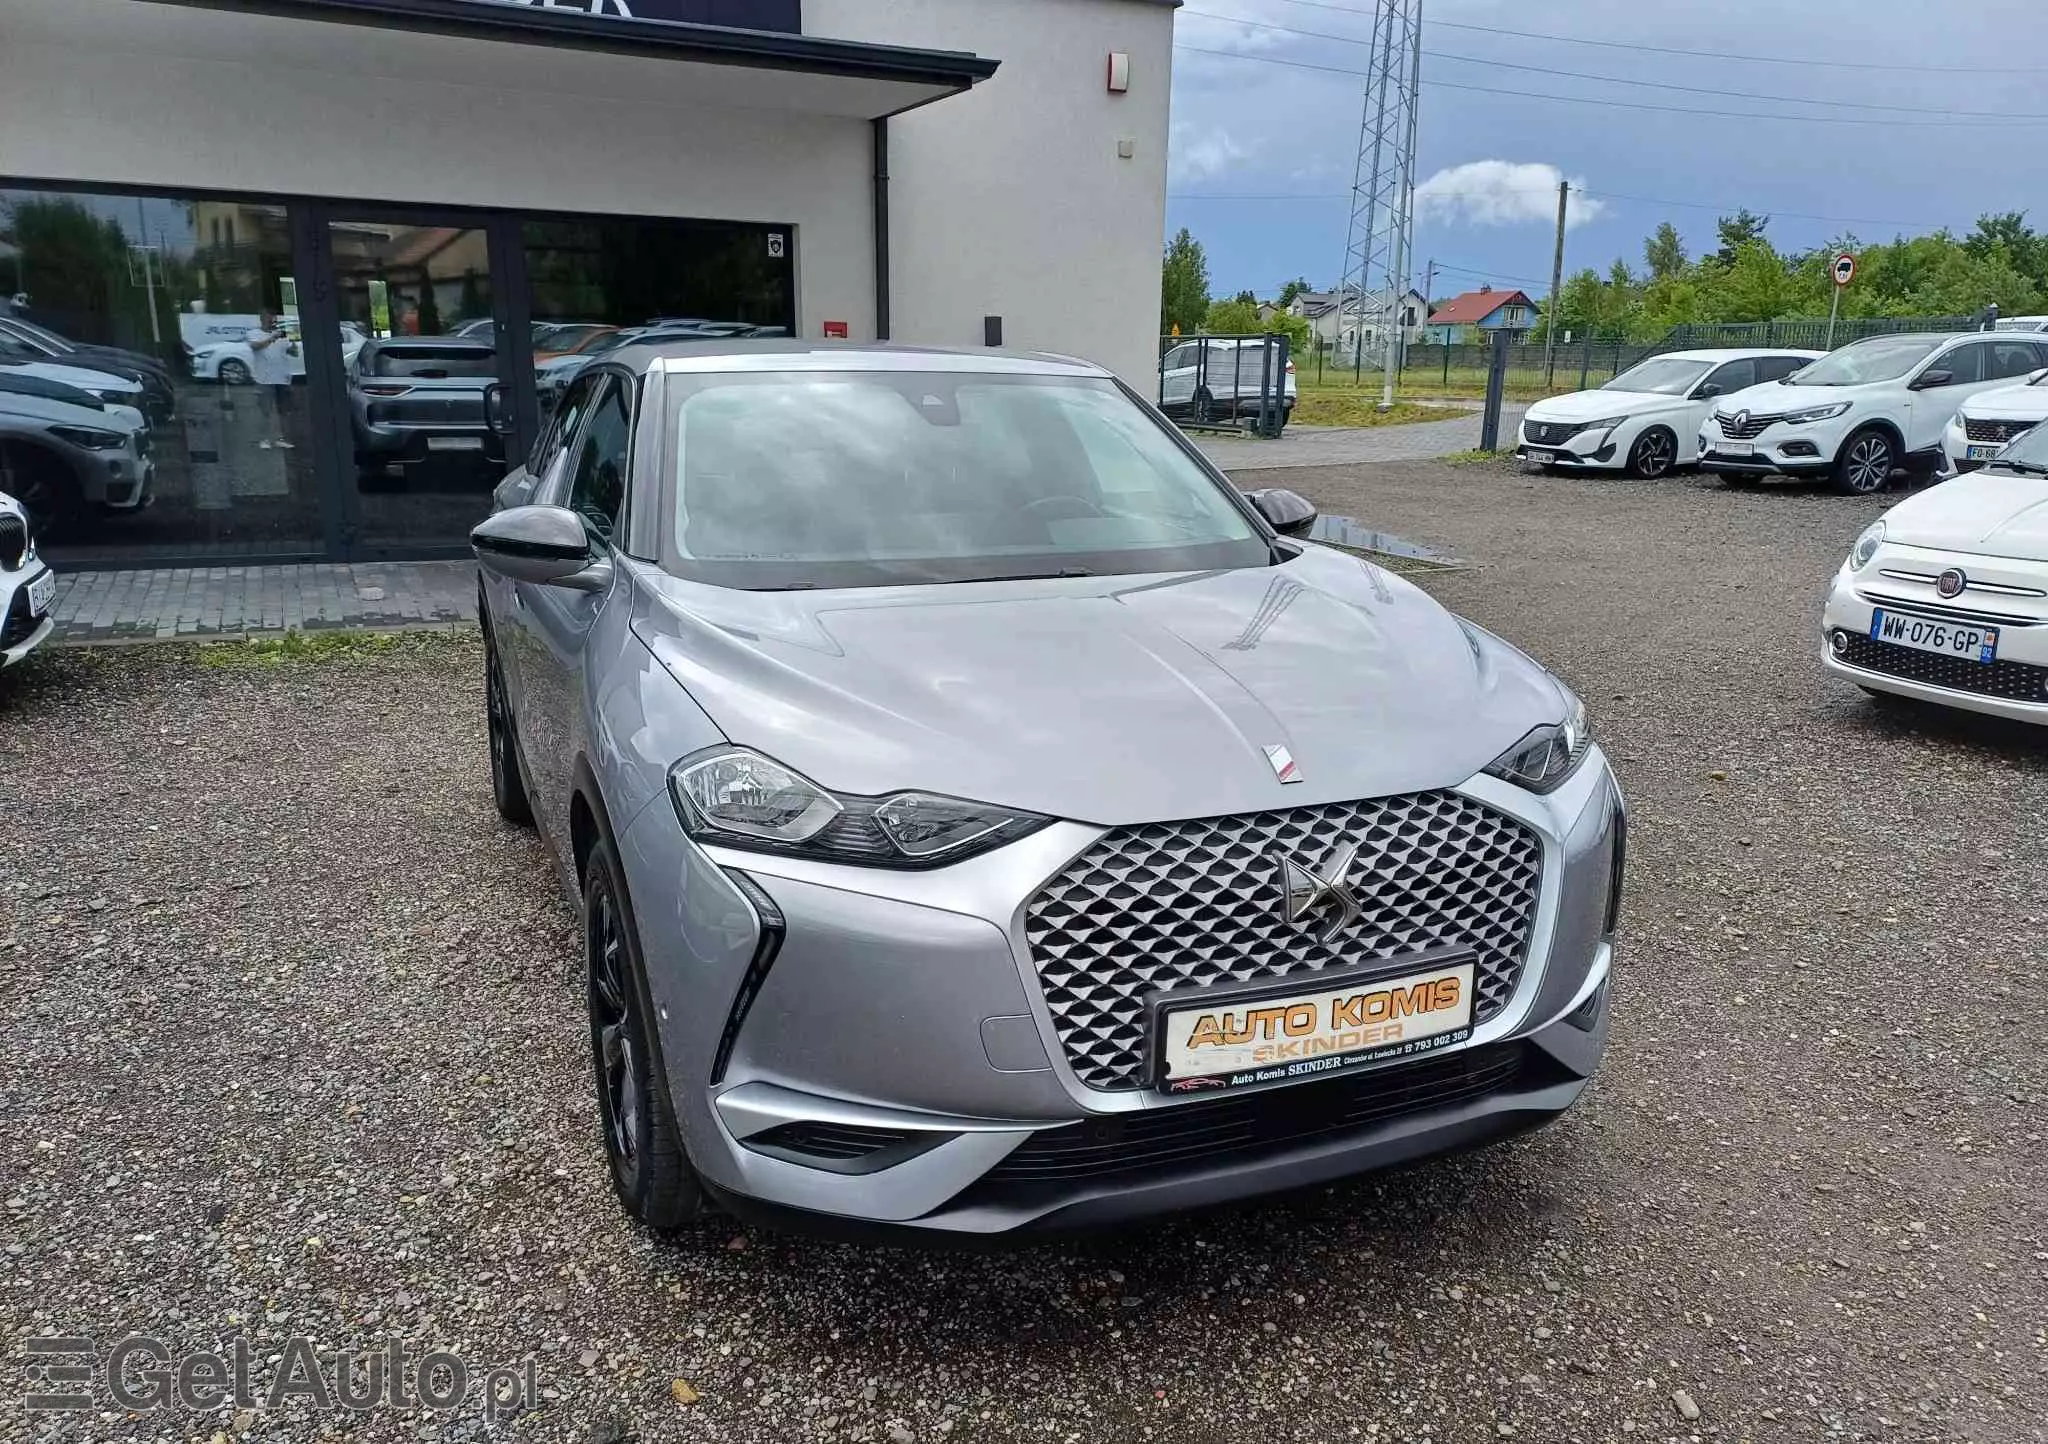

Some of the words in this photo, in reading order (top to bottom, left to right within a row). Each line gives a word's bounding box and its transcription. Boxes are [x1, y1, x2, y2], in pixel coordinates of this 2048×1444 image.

[1883, 615, 1979, 653] WW-076-GP
[1982, 647, 1993, 658] 92
[1186, 1003, 1317, 1050] AUTO
[1330, 976, 1461, 1030] KOMIS
[1231, 1074, 1254, 1086] Auto
[1256, 1067, 1286, 1082] Komis
[1287, 1056, 1342, 1077] SKINDER
[1414, 1039, 1432, 1053] 793
[1433, 1034, 1451, 1047] 002
[1451, 1029, 1469, 1042] 309
[1252, 1025, 1404, 1064] SKINDER
